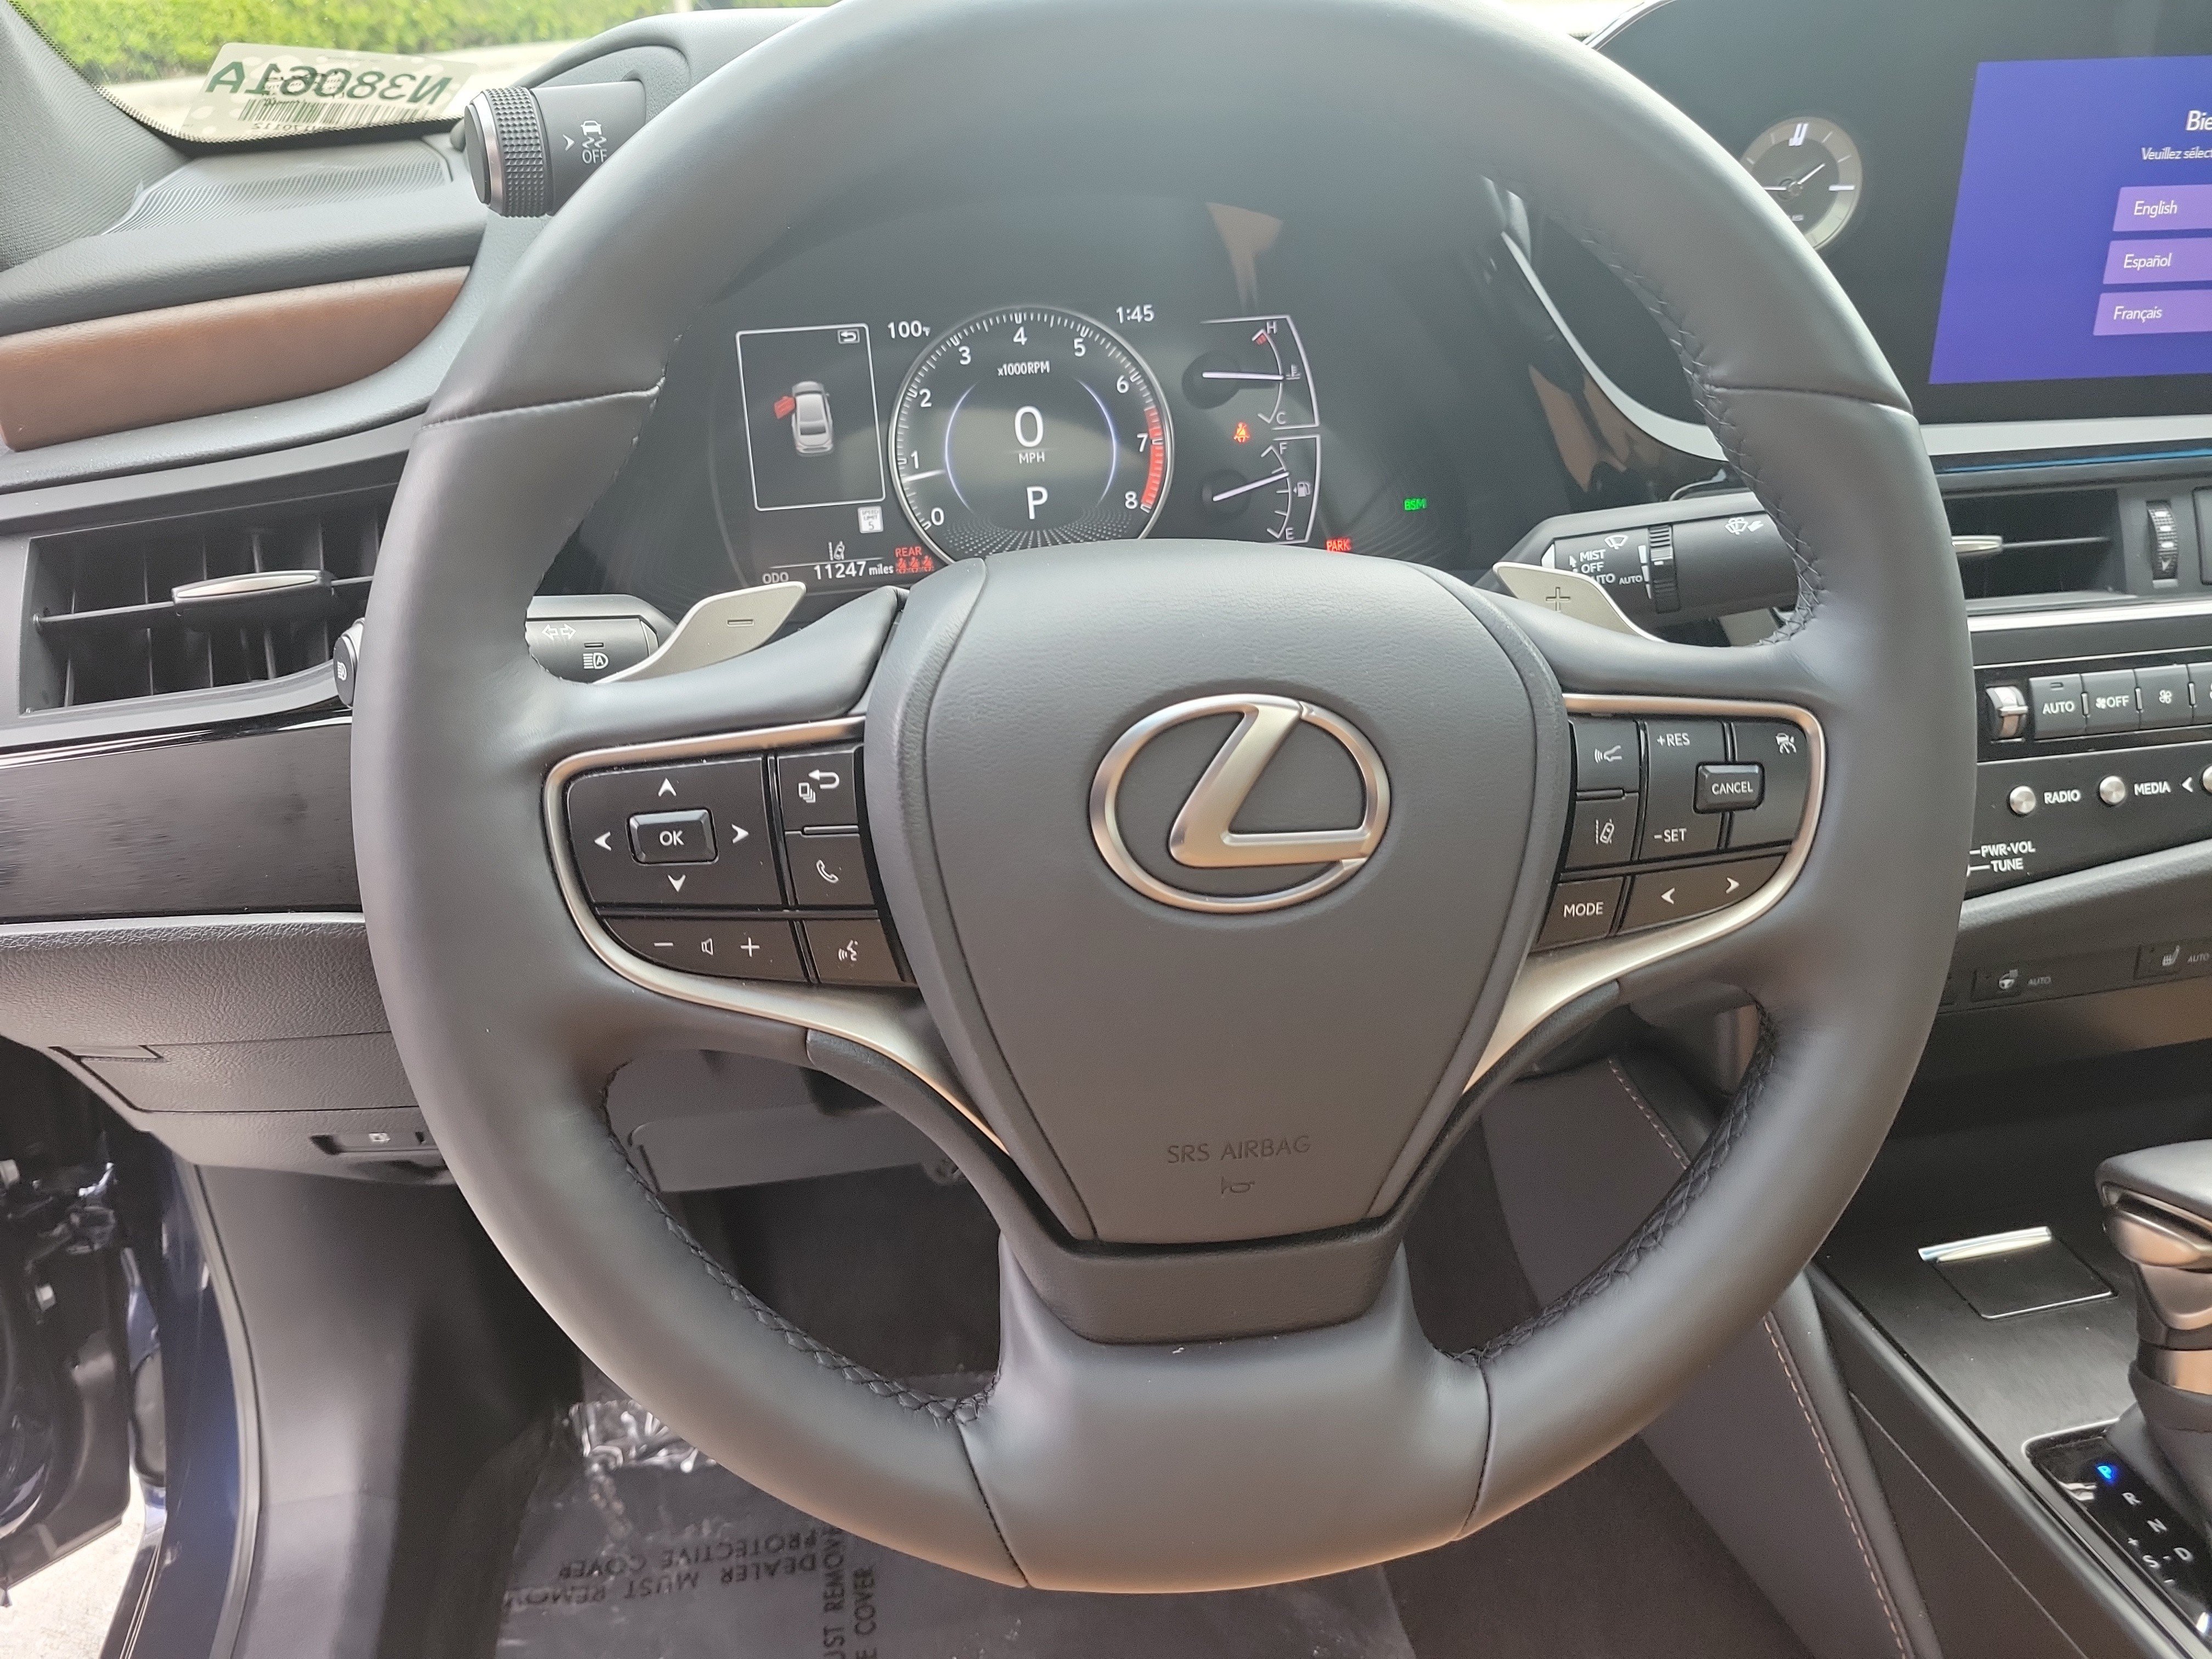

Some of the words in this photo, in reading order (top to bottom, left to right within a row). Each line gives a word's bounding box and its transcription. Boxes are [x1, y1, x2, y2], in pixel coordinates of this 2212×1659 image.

[582, 149, 607, 163] OFF
[2141, 146, 2181, 160] Veuillez
[2134, 200, 2178, 218] English
[2124, 252, 2172, 270] Español
[1116, 303, 1155, 323] 1:45
[2113, 305, 2163, 323] Français
[1013, 326, 1028, 345] 4
[1266, 321, 1277, 334] H
[959, 346, 972, 365] 3
[1073, 338, 1086, 357] 5
[997, 360, 1051, 376] x1000RPM
[1116, 375, 1129, 393] 6
[919, 388, 933, 408] 2
[1014, 405, 1044, 448] 0
[1276, 412, 1286, 425] C
[1137, 432, 1148, 453] 7
[1279, 442, 1288, 454] F
[910, 450, 919, 469] 1
[1018, 452, 1046, 465] MPH
[1026, 486, 1048, 520] P
[1124, 490, 1138, 510] 8
[1403, 497, 1426, 511] BSM
[931, 507, 945, 526] 0
[1285, 527, 1294, 540] E
[895, 546, 923, 558] REAR
[1326, 538, 1351, 552] PARK
[1579, 549, 1606, 562] MIST
[762, 571, 789, 584] ODO
[814, 561, 867, 580] 11247
[868, 563, 894, 575] miles
[1581, 561, 1605, 574] OFF
[1619, 574, 1643, 585] AUTO
[2042, 701, 2075, 714] AUTO
[2106, 695, 2130, 708] OFF
[1711, 781, 1753, 795] CANCEL
[2134, 781, 2171, 796] MEDIA
[2044, 789, 2081, 805] RADIO
[659, 830, 685, 846] OK
[1990, 857, 2024, 873] TUNE
[1564, 901, 1604, 917] MODE
[2187, 952, 2210, 963] AUTO
[2028, 977, 2052, 986] AUTO
[1167, 1143, 1210, 1164] SRS
[1220, 1135, 1311, 1161] AIRBAG
[2097, 1465, 2113, 1480] P
[2121, 1492, 2142, 1506] R
[2146, 1517, 2168, 1533] N
[660, 1530, 817, 1569] PROTECTIVE
[2174, 1547, 2194, 1561] D
[558, 1554, 648, 1579] COVER
[720, 1553, 818, 1585] DEALER
[2142, 1554, 2160, 1568] S
[623, 1571, 699, 1600] MUST
[504, 1585, 606, 1611] REMOV
[853, 1567, 877, 1636] COVER
[823, 1626, 845, 1659] UST
